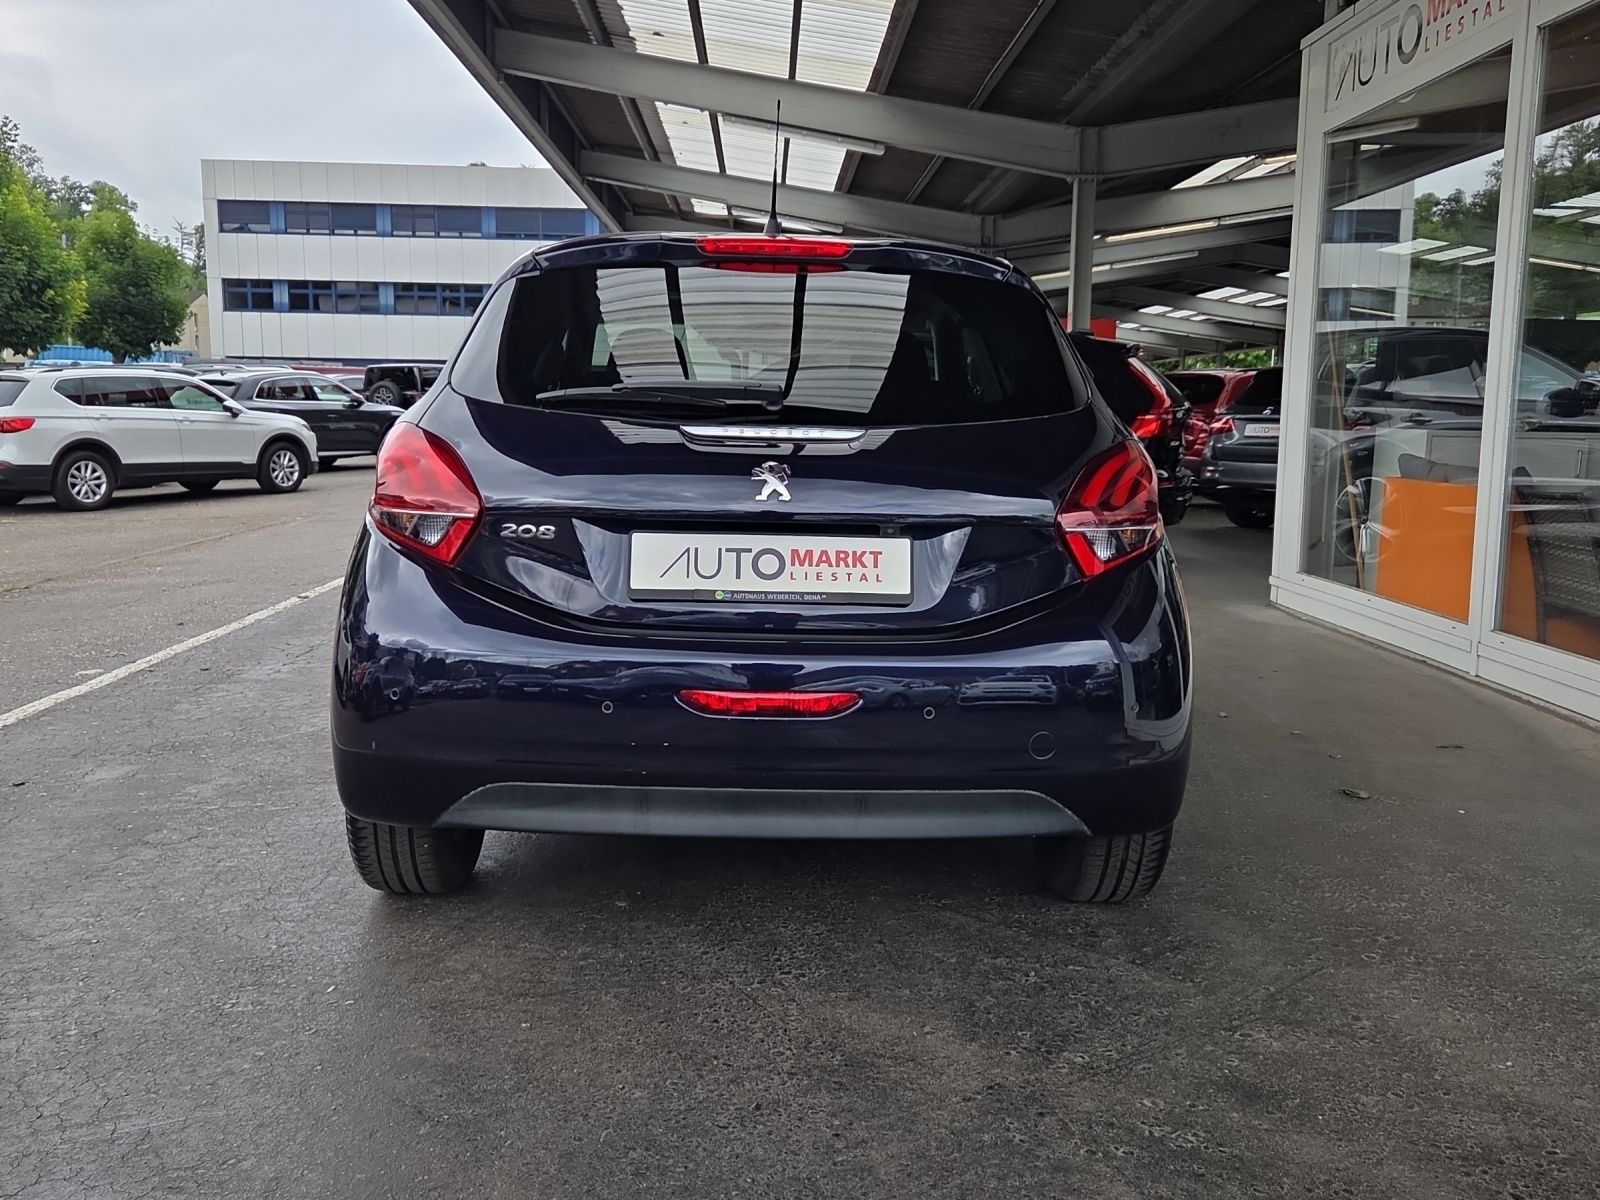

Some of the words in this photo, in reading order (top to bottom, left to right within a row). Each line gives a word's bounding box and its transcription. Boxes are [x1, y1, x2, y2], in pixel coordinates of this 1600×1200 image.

[1424, 0, 1505, 53] LIESTAL
[1335, 3, 1424, 101] AUTO
[500, 523, 556, 540] 208
[659, 546, 786, 581] AUTO
[790, 549, 883, 569] MARKT
[790, 571, 883, 583] LIESTAL
